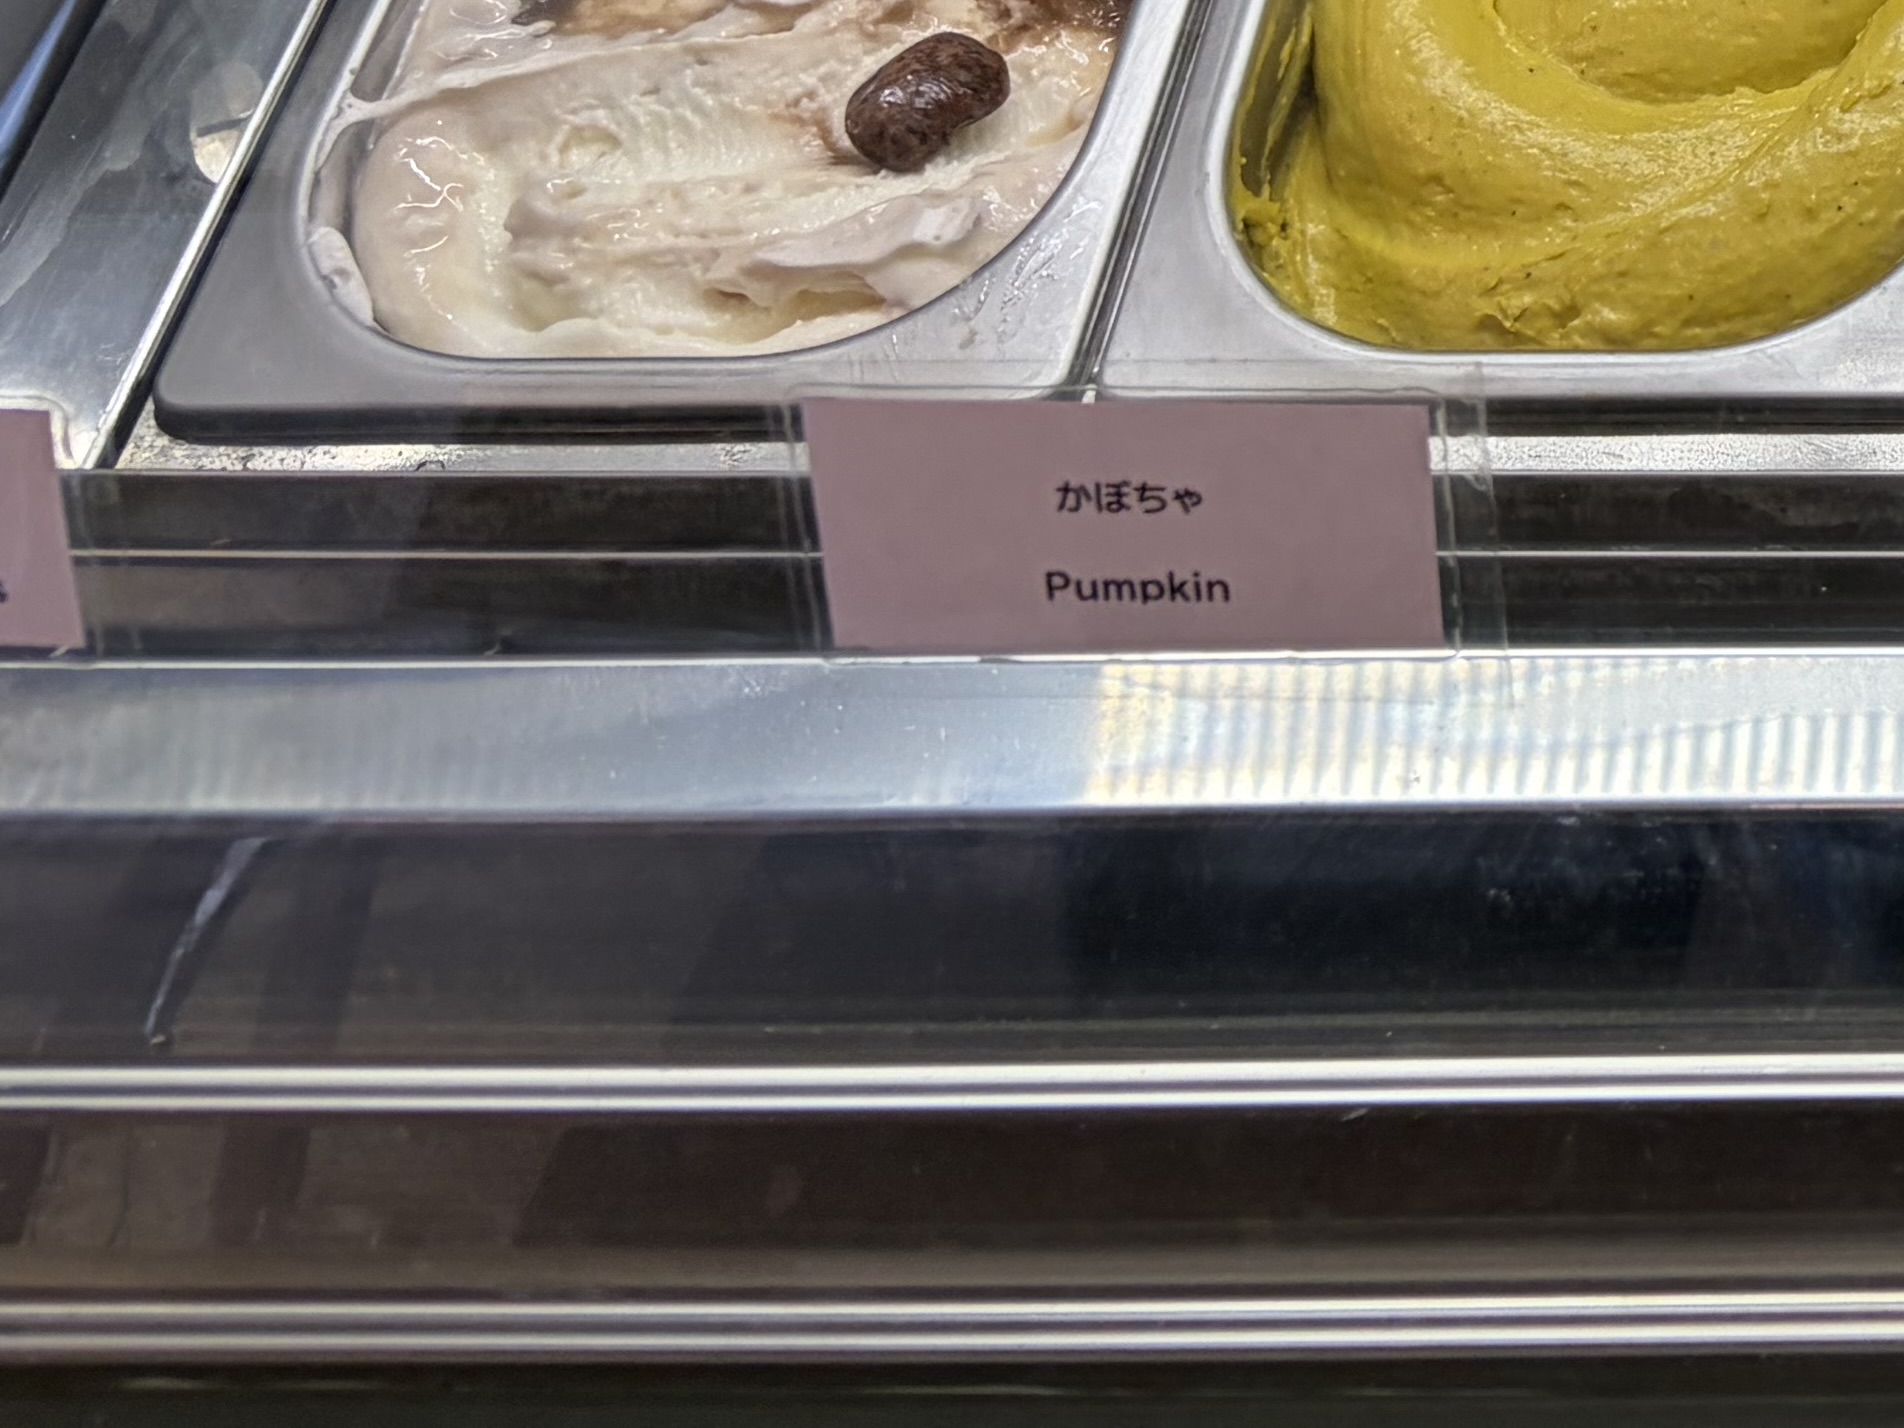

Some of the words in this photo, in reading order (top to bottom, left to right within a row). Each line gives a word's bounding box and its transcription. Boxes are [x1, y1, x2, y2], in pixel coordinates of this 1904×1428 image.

[1055, 479, 1204, 516] かぼちゃ
[1044, 570, 1232, 606] Pumpkin
